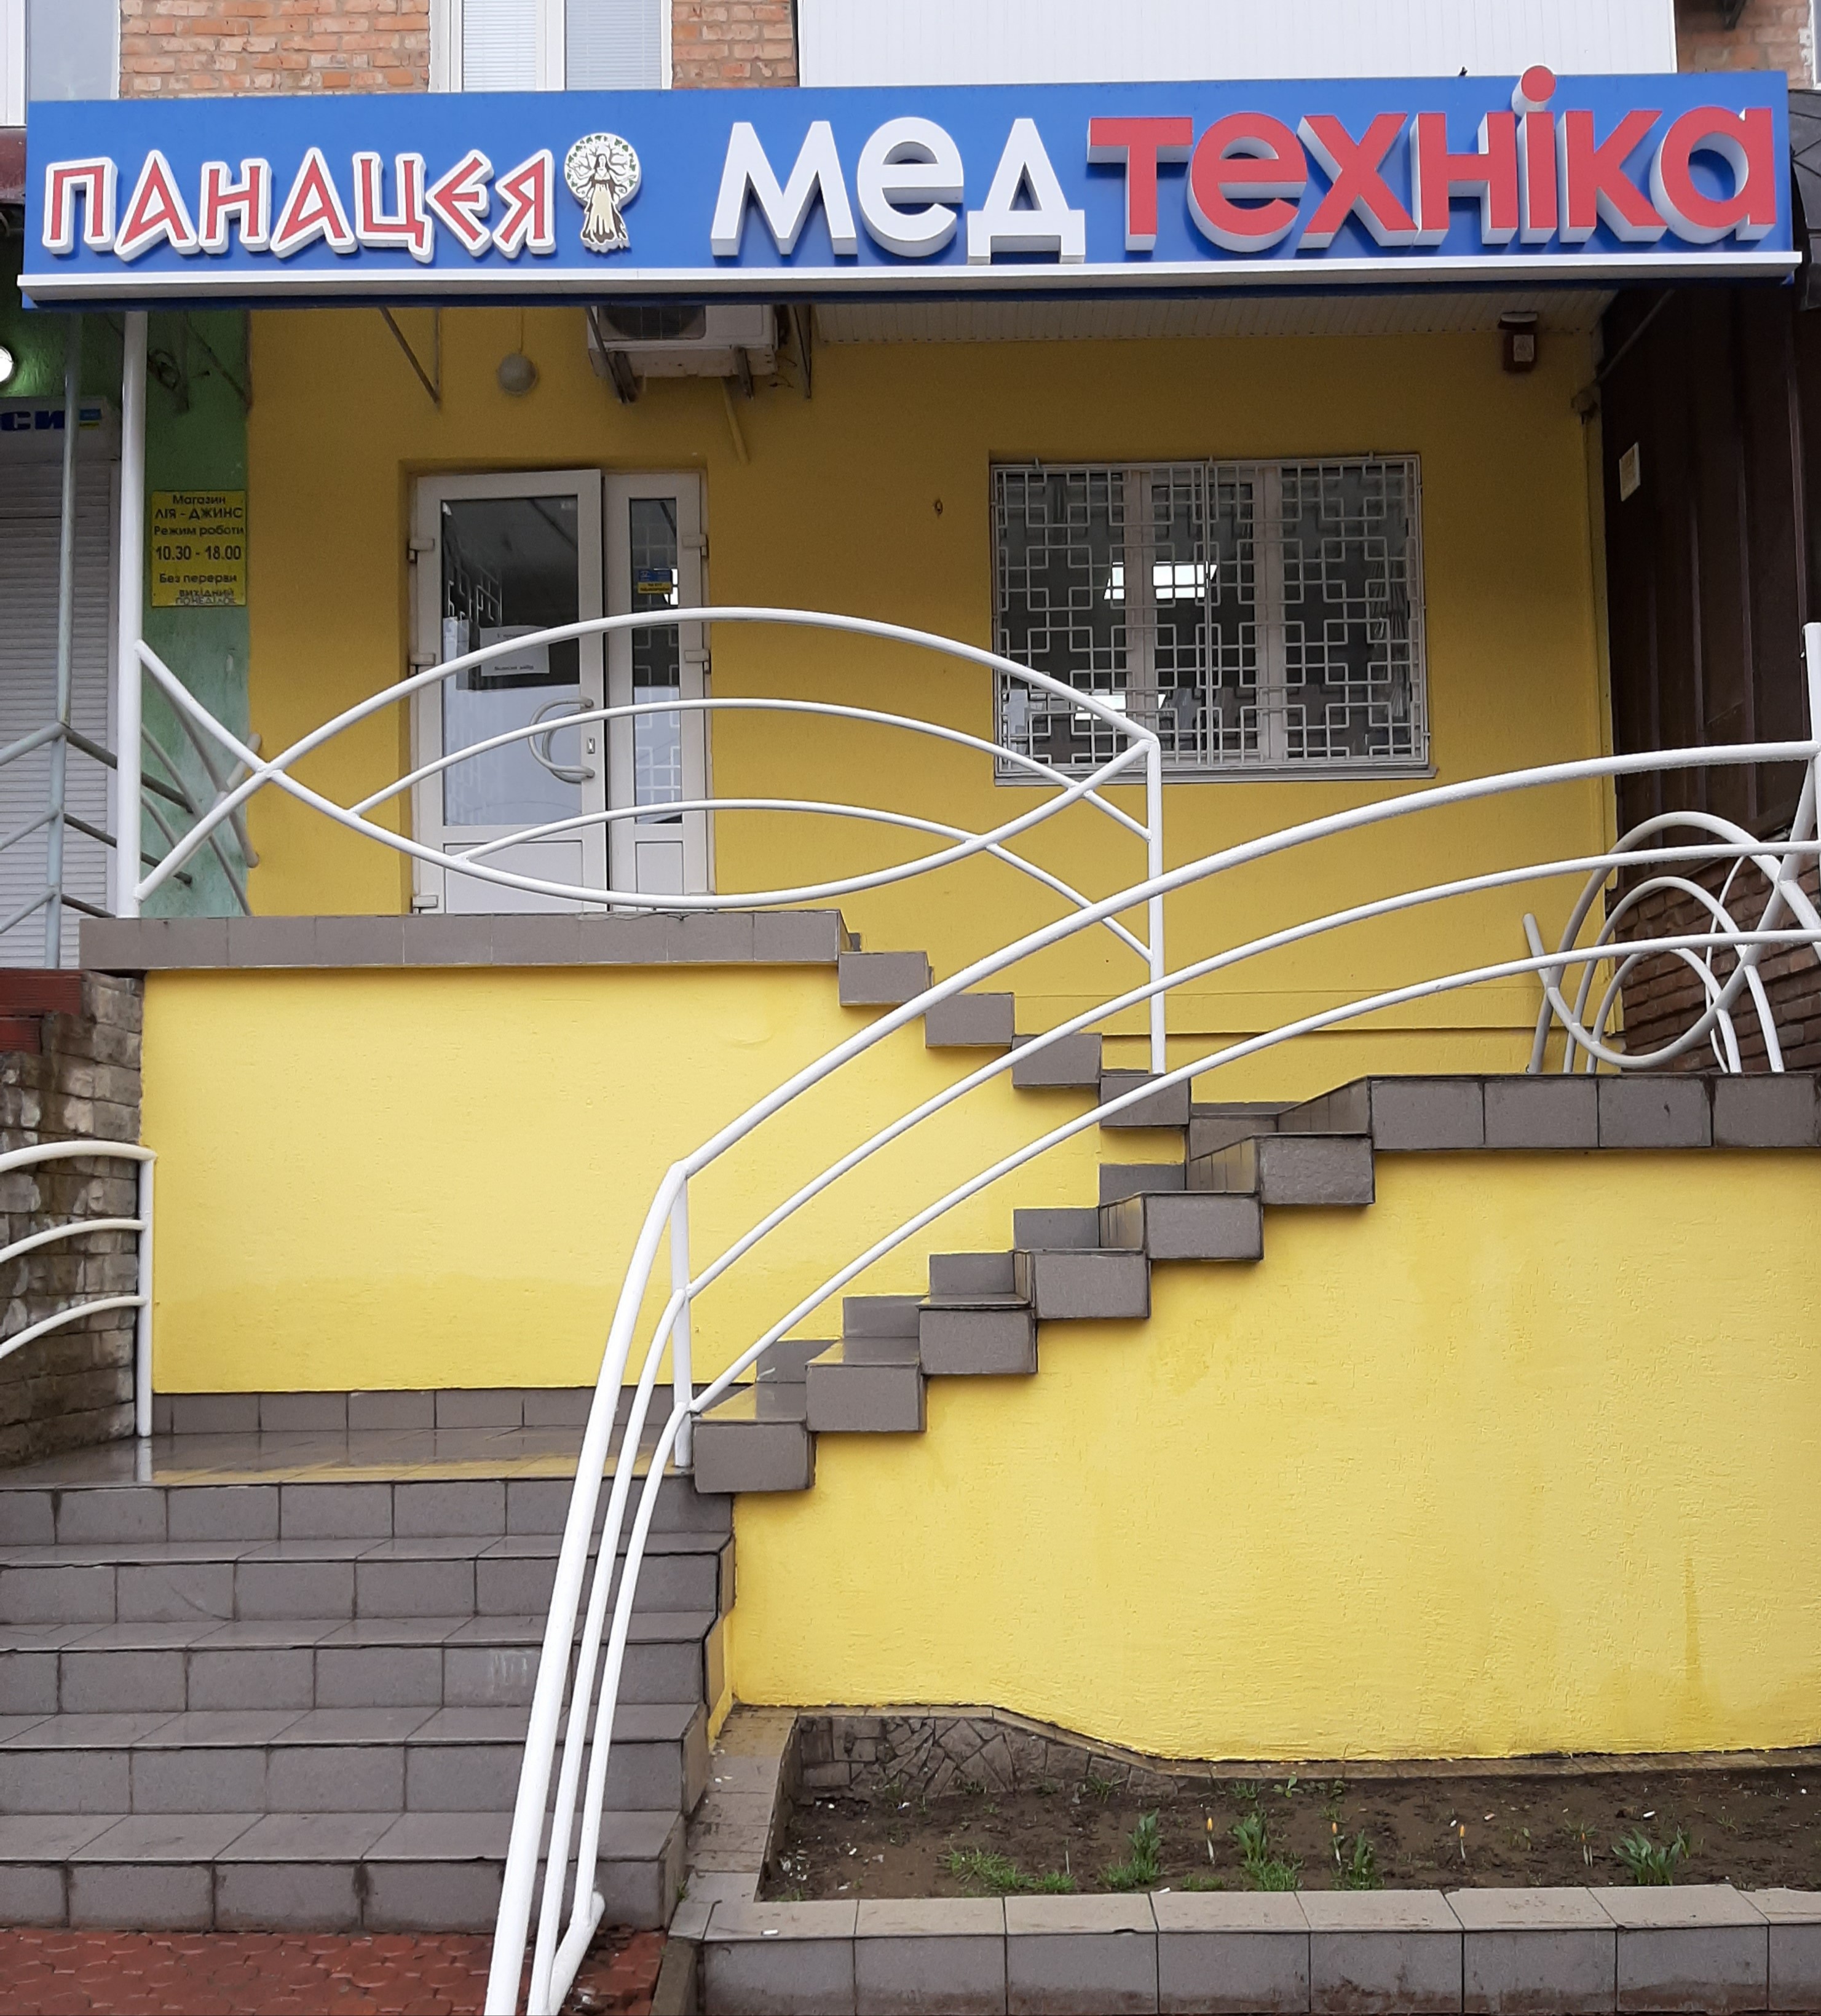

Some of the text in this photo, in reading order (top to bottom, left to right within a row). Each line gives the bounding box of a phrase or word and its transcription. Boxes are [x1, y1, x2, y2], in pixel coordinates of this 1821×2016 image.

[42, 146, 556, 264] ПАНАЦЕЯ
[173, 494, 226, 505] Магазин
[188, 507, 243, 520] ДЖИНС
[154, 524, 245, 537] Режим роботи
[156, 545, 192, 561] 10.30
[205, 545, 242, 561] 18.00
[159, 573, 181, 583] Без
